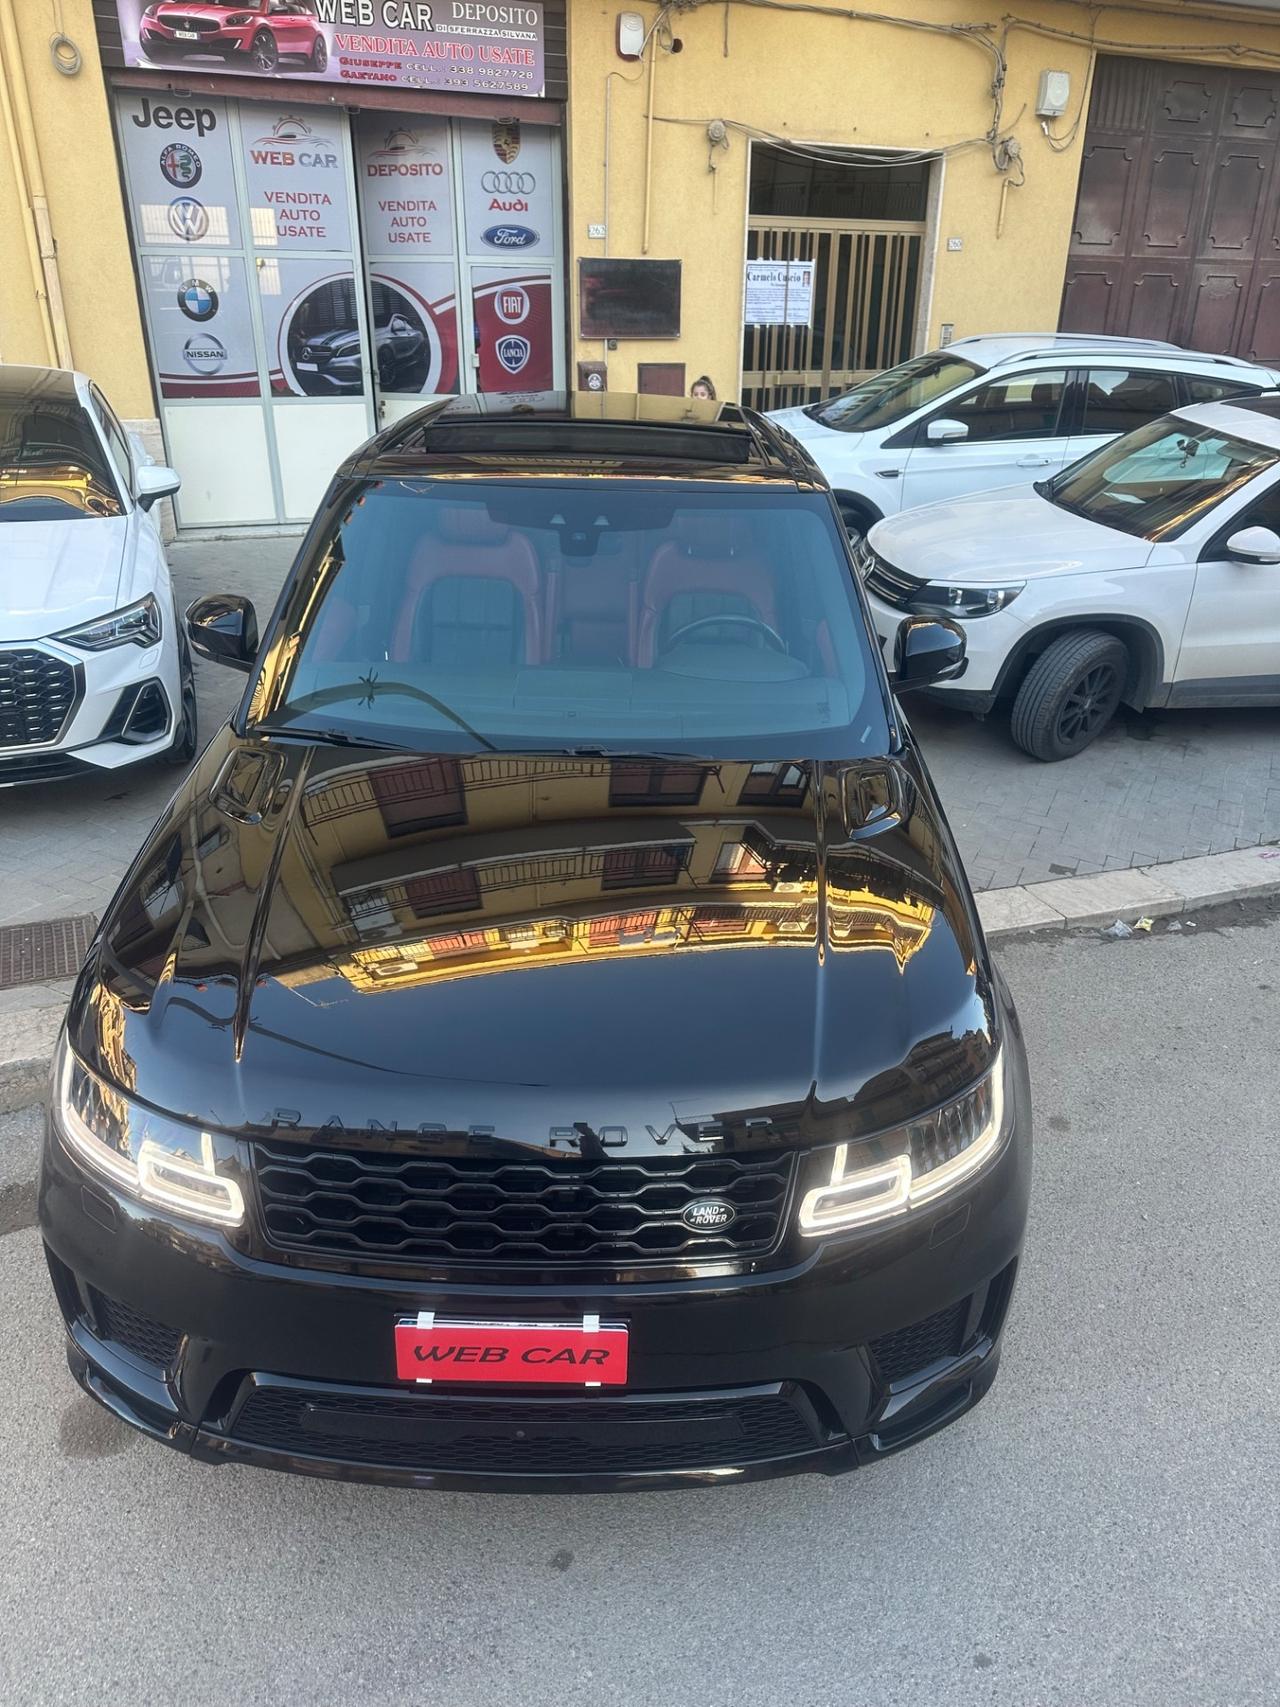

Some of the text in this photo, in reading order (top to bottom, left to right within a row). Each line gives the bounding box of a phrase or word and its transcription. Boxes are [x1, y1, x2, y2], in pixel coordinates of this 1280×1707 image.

[315, 0, 434, 32] WEB CAR
[452, 2, 538, 26] DEPOSITO
[449, 26, 499, 36] SFERRAZZA
[502, 30, 538, 40] SILVANA
[335, 32, 535, 66] VENDITA AUTO USATE
[450, 65, 474, 75] 338
[478, 67, 533, 79] 9827728
[340, 69, 398, 82] GAETANO
[474, 79, 529, 91] 5627589
[132, 98, 217, 137] Jeep
[250, 150, 339, 168] WEB CAR
[367, 163, 444, 177] DEPOSITO
[264, 191, 332, 205] VENDITA
[488, 198, 529, 212] Audi
[378, 200, 437, 212] VENDITA
[279, 209, 321, 221] AUTO
[390, 217, 427, 227] AUTO
[277, 226, 326, 238] USATE
[388, 232, 431, 243] USATE
[494, 228, 526, 245] Ford
[180, 279, 214, 293] BMW
[502, 296, 523, 313] FIAT
[503, 348, 524, 358] LANCIA
[271, 1107, 775, 1148] RANGE ROVER
[692, 1206, 720, 1216] LAND
[695, 1214, 728, 1225] ROVER
[413, 1345, 610, 1366] WEB CAR
